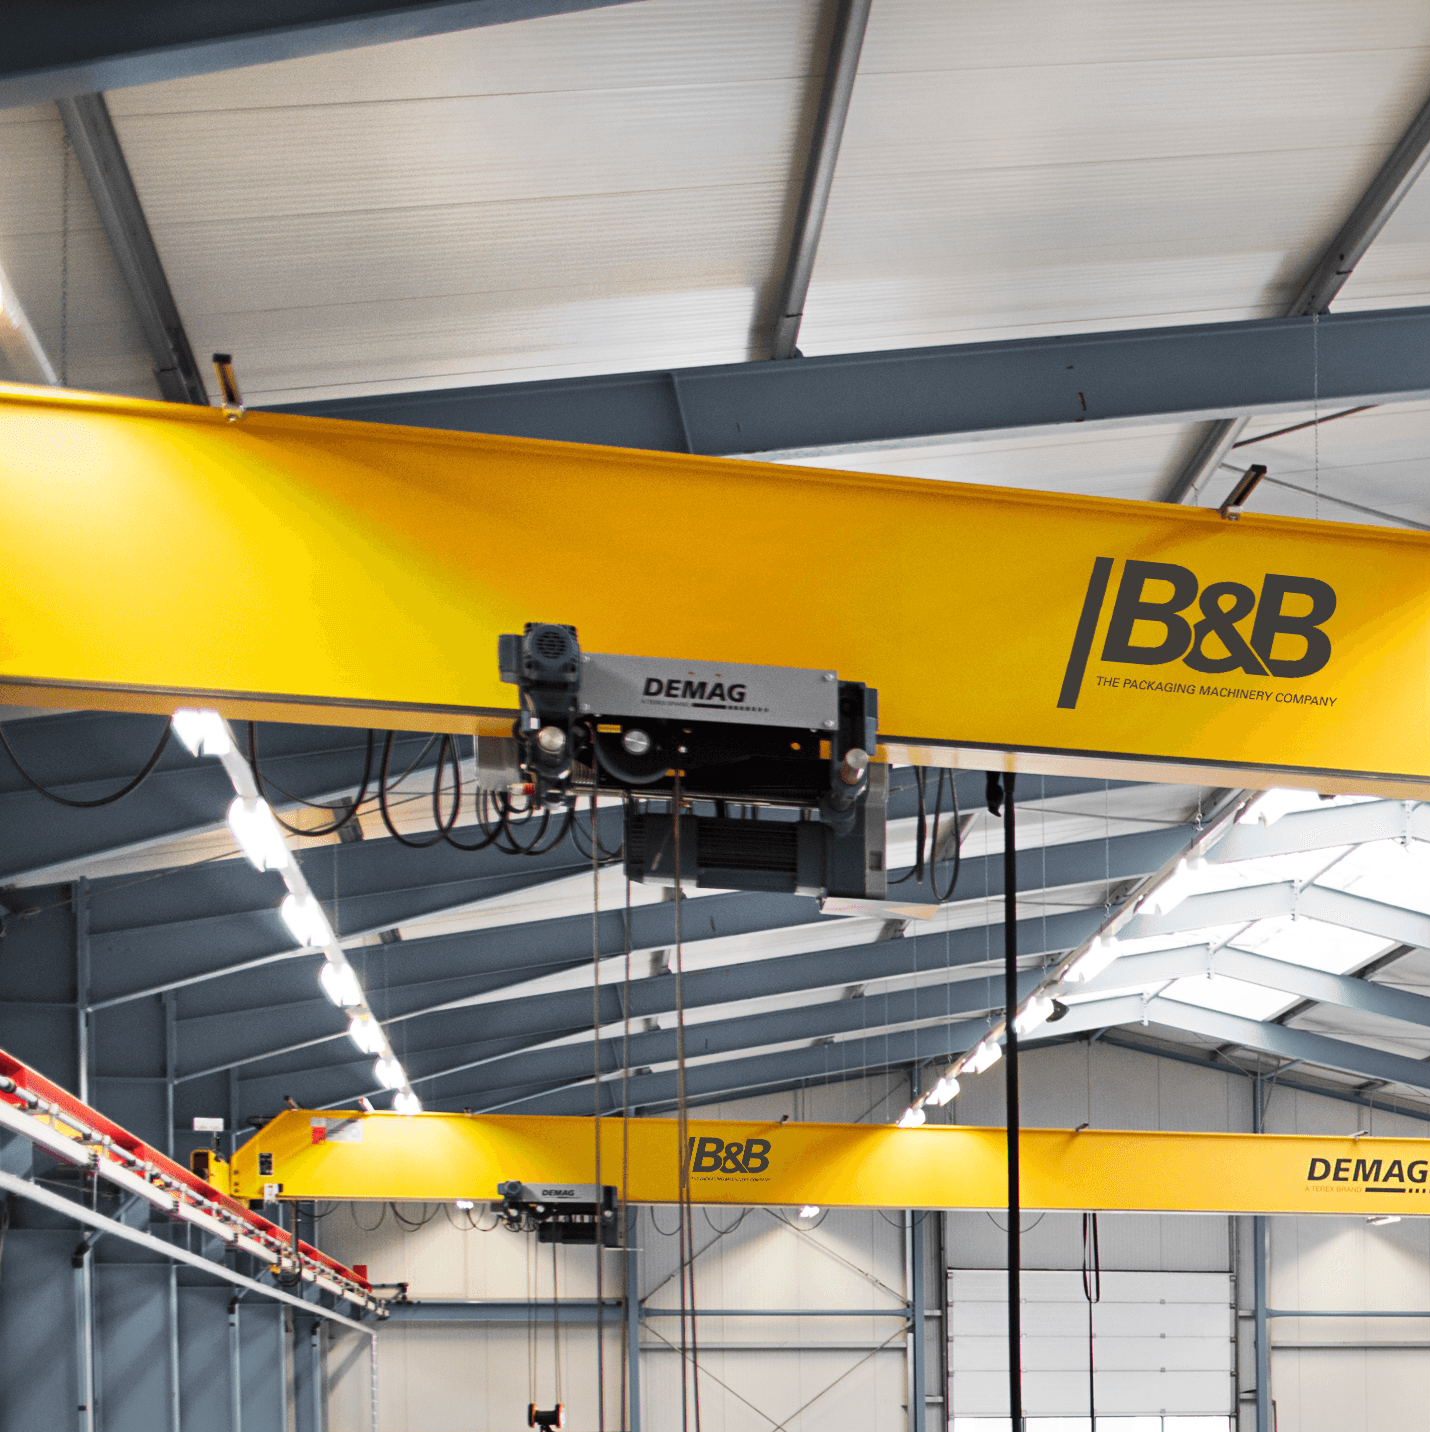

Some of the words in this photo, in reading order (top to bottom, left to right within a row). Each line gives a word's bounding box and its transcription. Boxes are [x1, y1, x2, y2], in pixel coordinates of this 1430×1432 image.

[1101, 558, 1337, 678] B&B
[642, 677, 747, 703] DEMAG
[1096, 675, 1120, 688] THE
[1122, 678, 1196, 695] PACKAGING
[1199, 685, 1274, 702] MACHINERY
[1275, 691, 1338, 707] COMPANY
[692, 1136, 772, 1174] B&B
[1307, 1157, 1429, 1184] DEMAG
[541, 1189, 575, 1197] DEMAG
